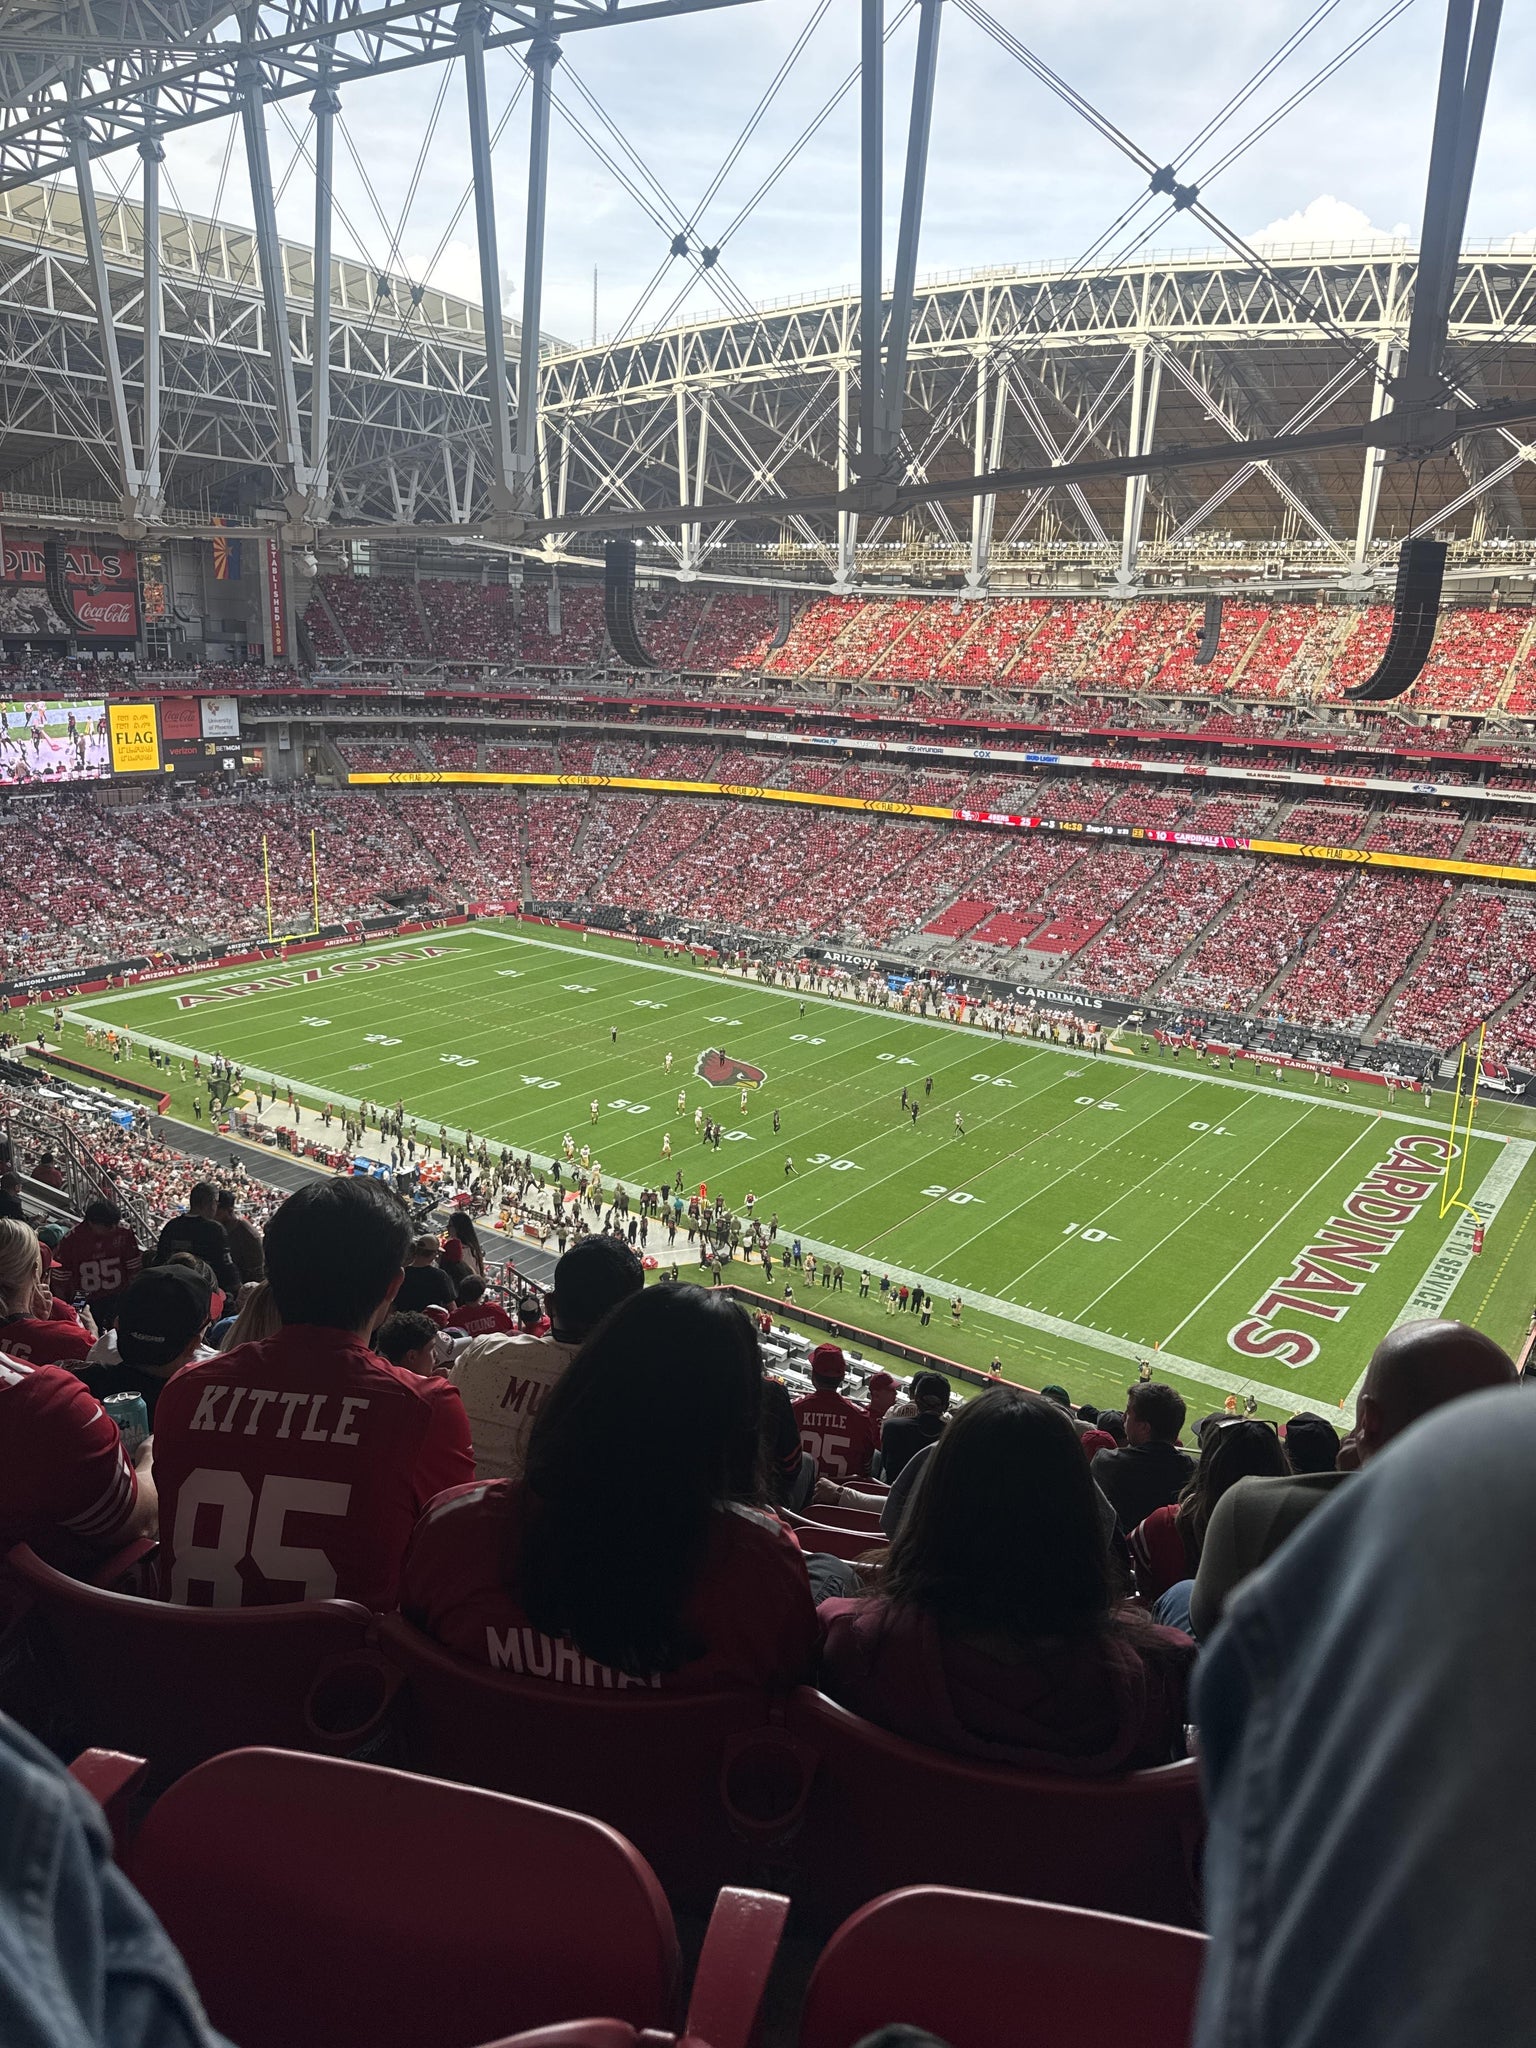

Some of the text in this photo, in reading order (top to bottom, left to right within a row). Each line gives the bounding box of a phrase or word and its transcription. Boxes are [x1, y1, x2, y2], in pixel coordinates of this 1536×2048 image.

[116, 731, 153, 745] FLAG
[169, 747, 197, 755] verizon
[1173, 833, 1219, 844] CARDINALS
[1327, 848, 1343, 858] FLAG
[324, 937, 352, 947] ARIZONA
[612, 932, 643, 943] CARDINAS
[13, 970, 86, 988] ARIZONA CARDINALS
[139, 968, 175, 981] ARIZONA
[170, 946, 471, 1010] ARIZONA
[1015, 985, 1104, 1010] CARDINALS
[439, 1052, 479, 1067] 30
[1243, 1052, 1281, 1065] ARIZONA
[520, 1075, 562, 1090] 40
[607, 1099, 651, 1115] 50
[806, 1153, 855, 1171] 30
[920, 1185, 975, 1204] 20
[1062, 1222, 1109, 1242] 10
[1227, 1135, 1461, 1369] CARDINALS
[80, 1257, 122, 1291] 85
[1412, 1257, 1463, 1311] SERVICE
[464, 1316, 496, 1333] YOUNG
[189, 1384, 370, 1446] KITTLE
[802, 1411, 848, 1430] KITTLE
[170, 1467, 352, 1608] 85
